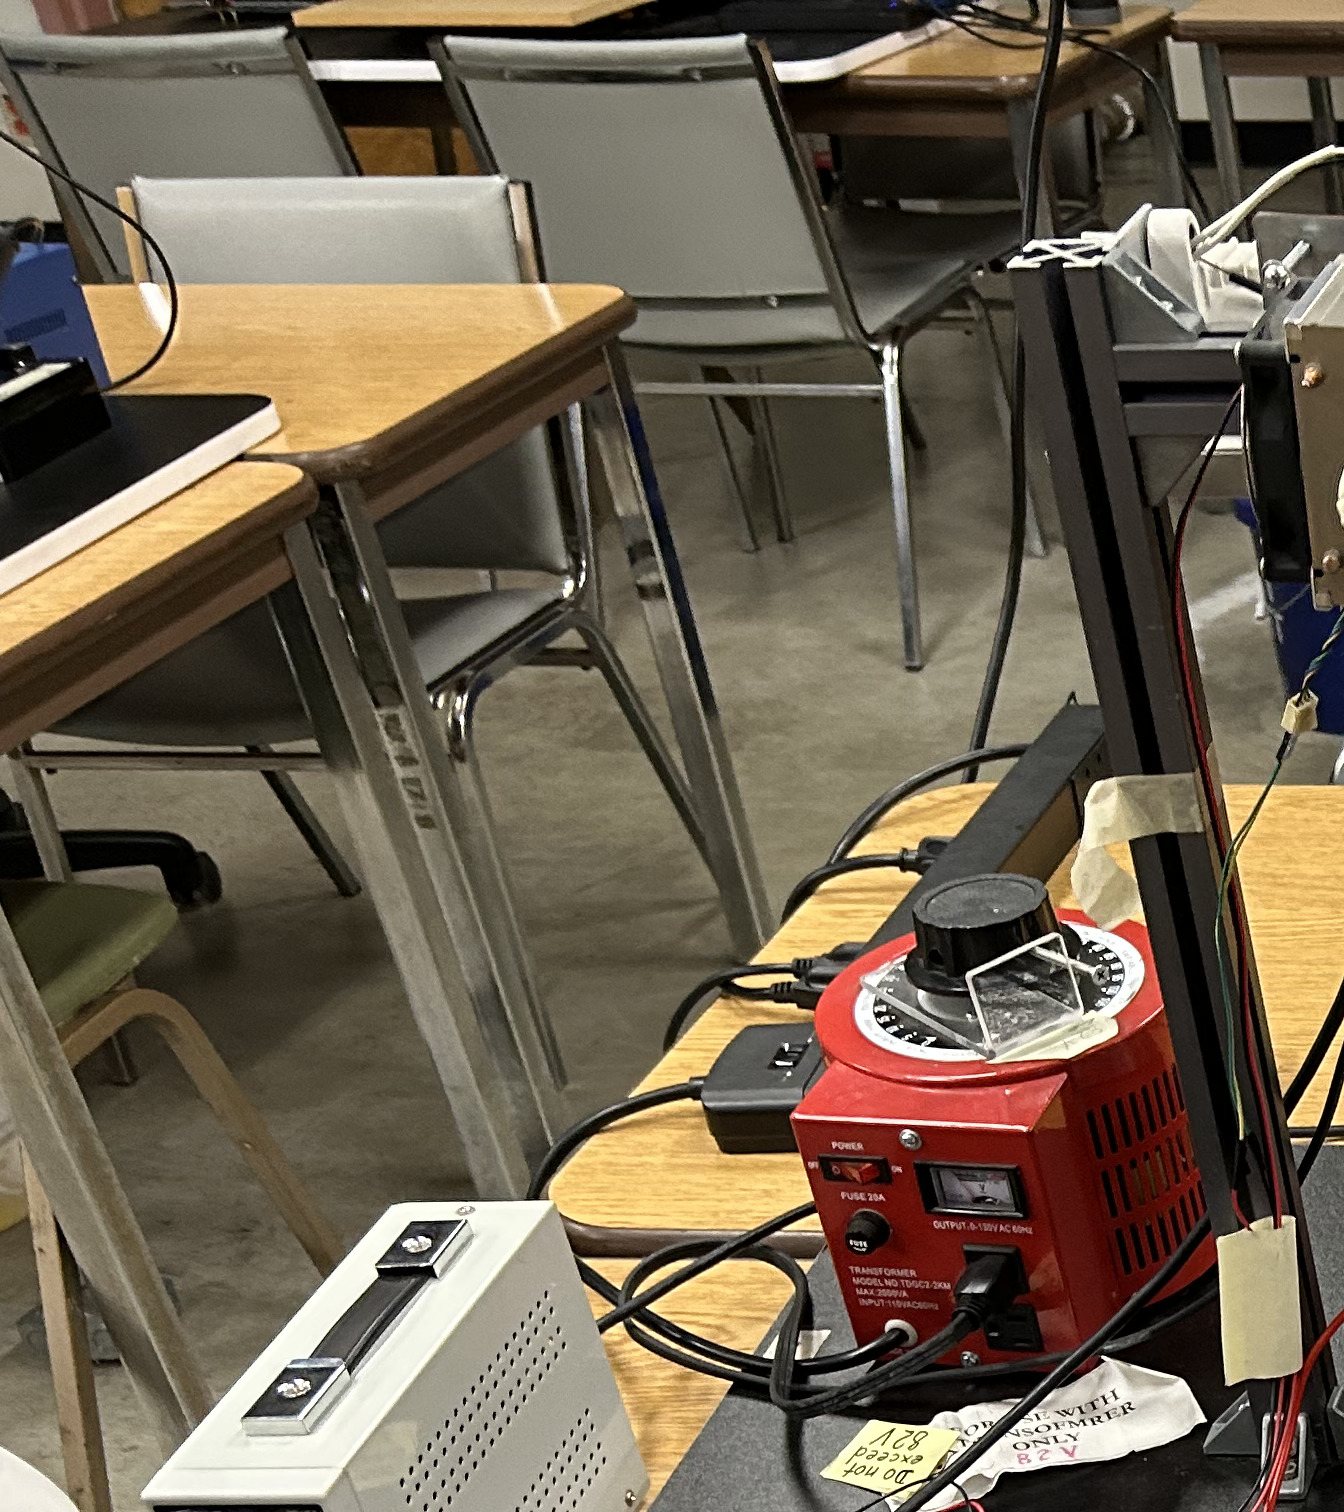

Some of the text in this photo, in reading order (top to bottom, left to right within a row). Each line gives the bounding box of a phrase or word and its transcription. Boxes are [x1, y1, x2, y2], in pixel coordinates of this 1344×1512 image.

[831, 1141, 865, 1151] POWER
[841, 1191, 866, 1201] FUSE
[848, 1266, 917, 1278] TRANSFORMER
[852, 1277, 884, 1287] MODEL
[1054, 1387, 1121, 1418] WITH
[869, 1428, 928, 1451] 82 V
[1012, 1431, 1081, 1451] ONLY
[845, 1446, 923, 1464] exceed
[1016, 1444, 1081, 1465] 82 V
[842, 1462, 914, 1484] Do not
